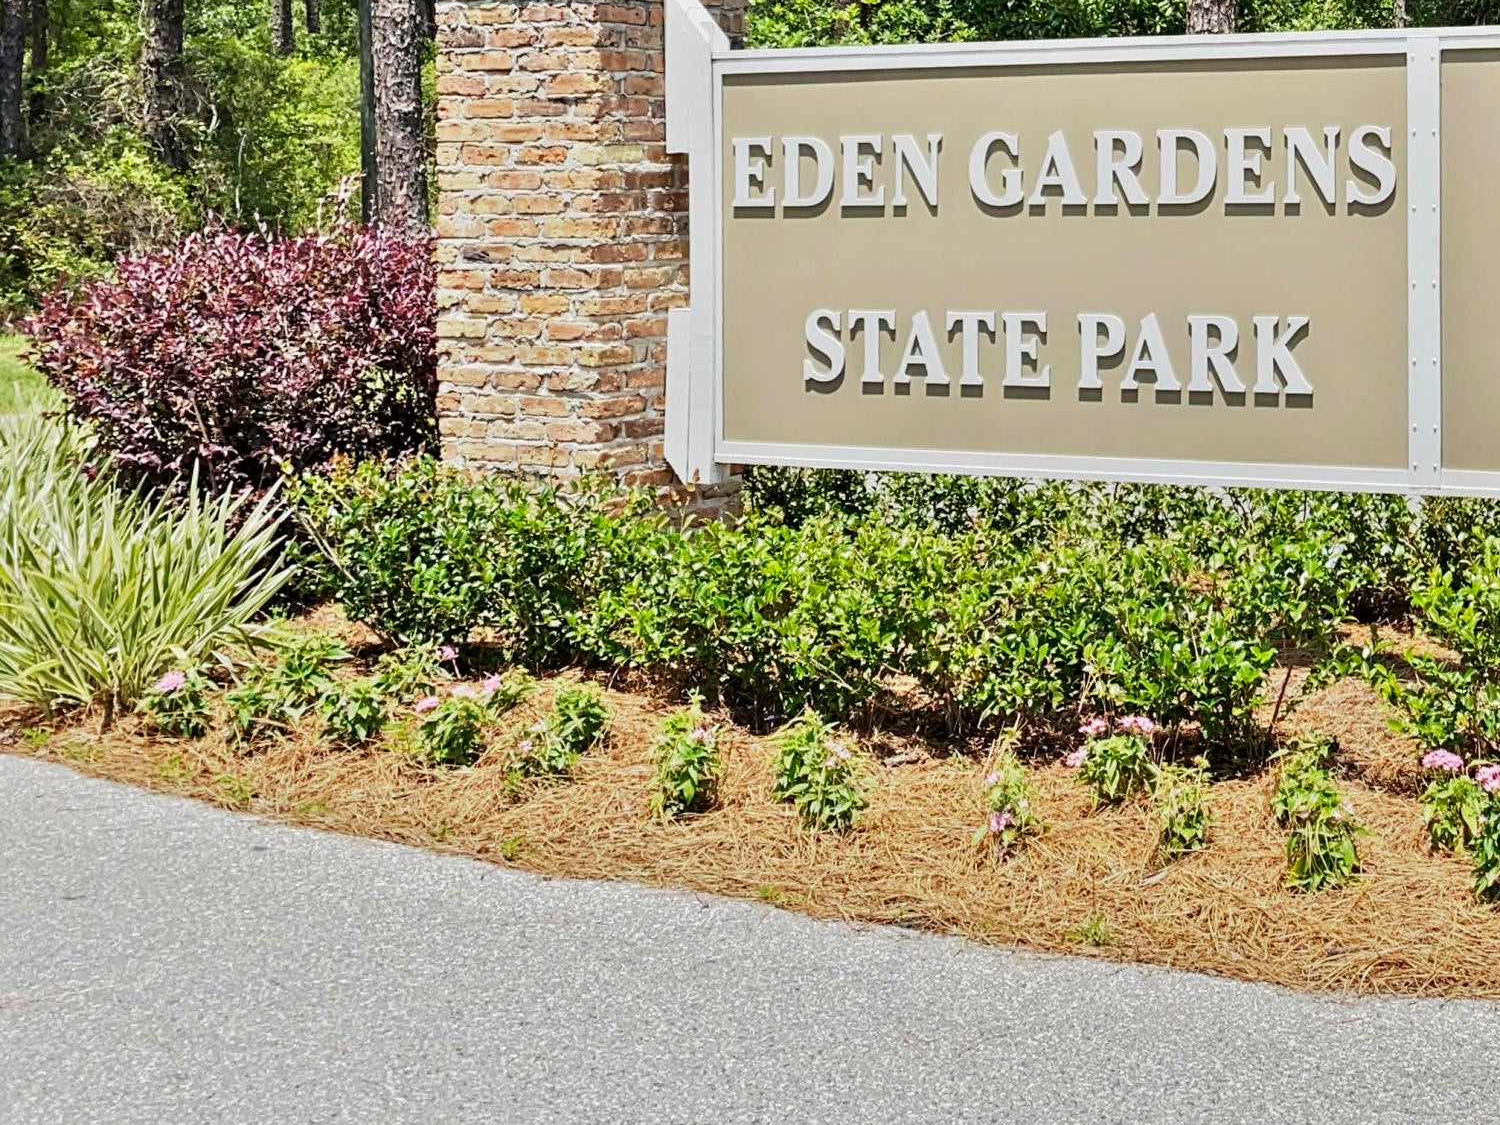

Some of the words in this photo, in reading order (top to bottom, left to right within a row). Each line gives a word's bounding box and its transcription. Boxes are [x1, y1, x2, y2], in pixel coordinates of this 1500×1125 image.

[731, 134, 942, 208] EDEN
[968, 125, 1396, 208] GARDENS
[803, 309, 1051, 387] STATE
[1077, 311, 1315, 395] PARK
